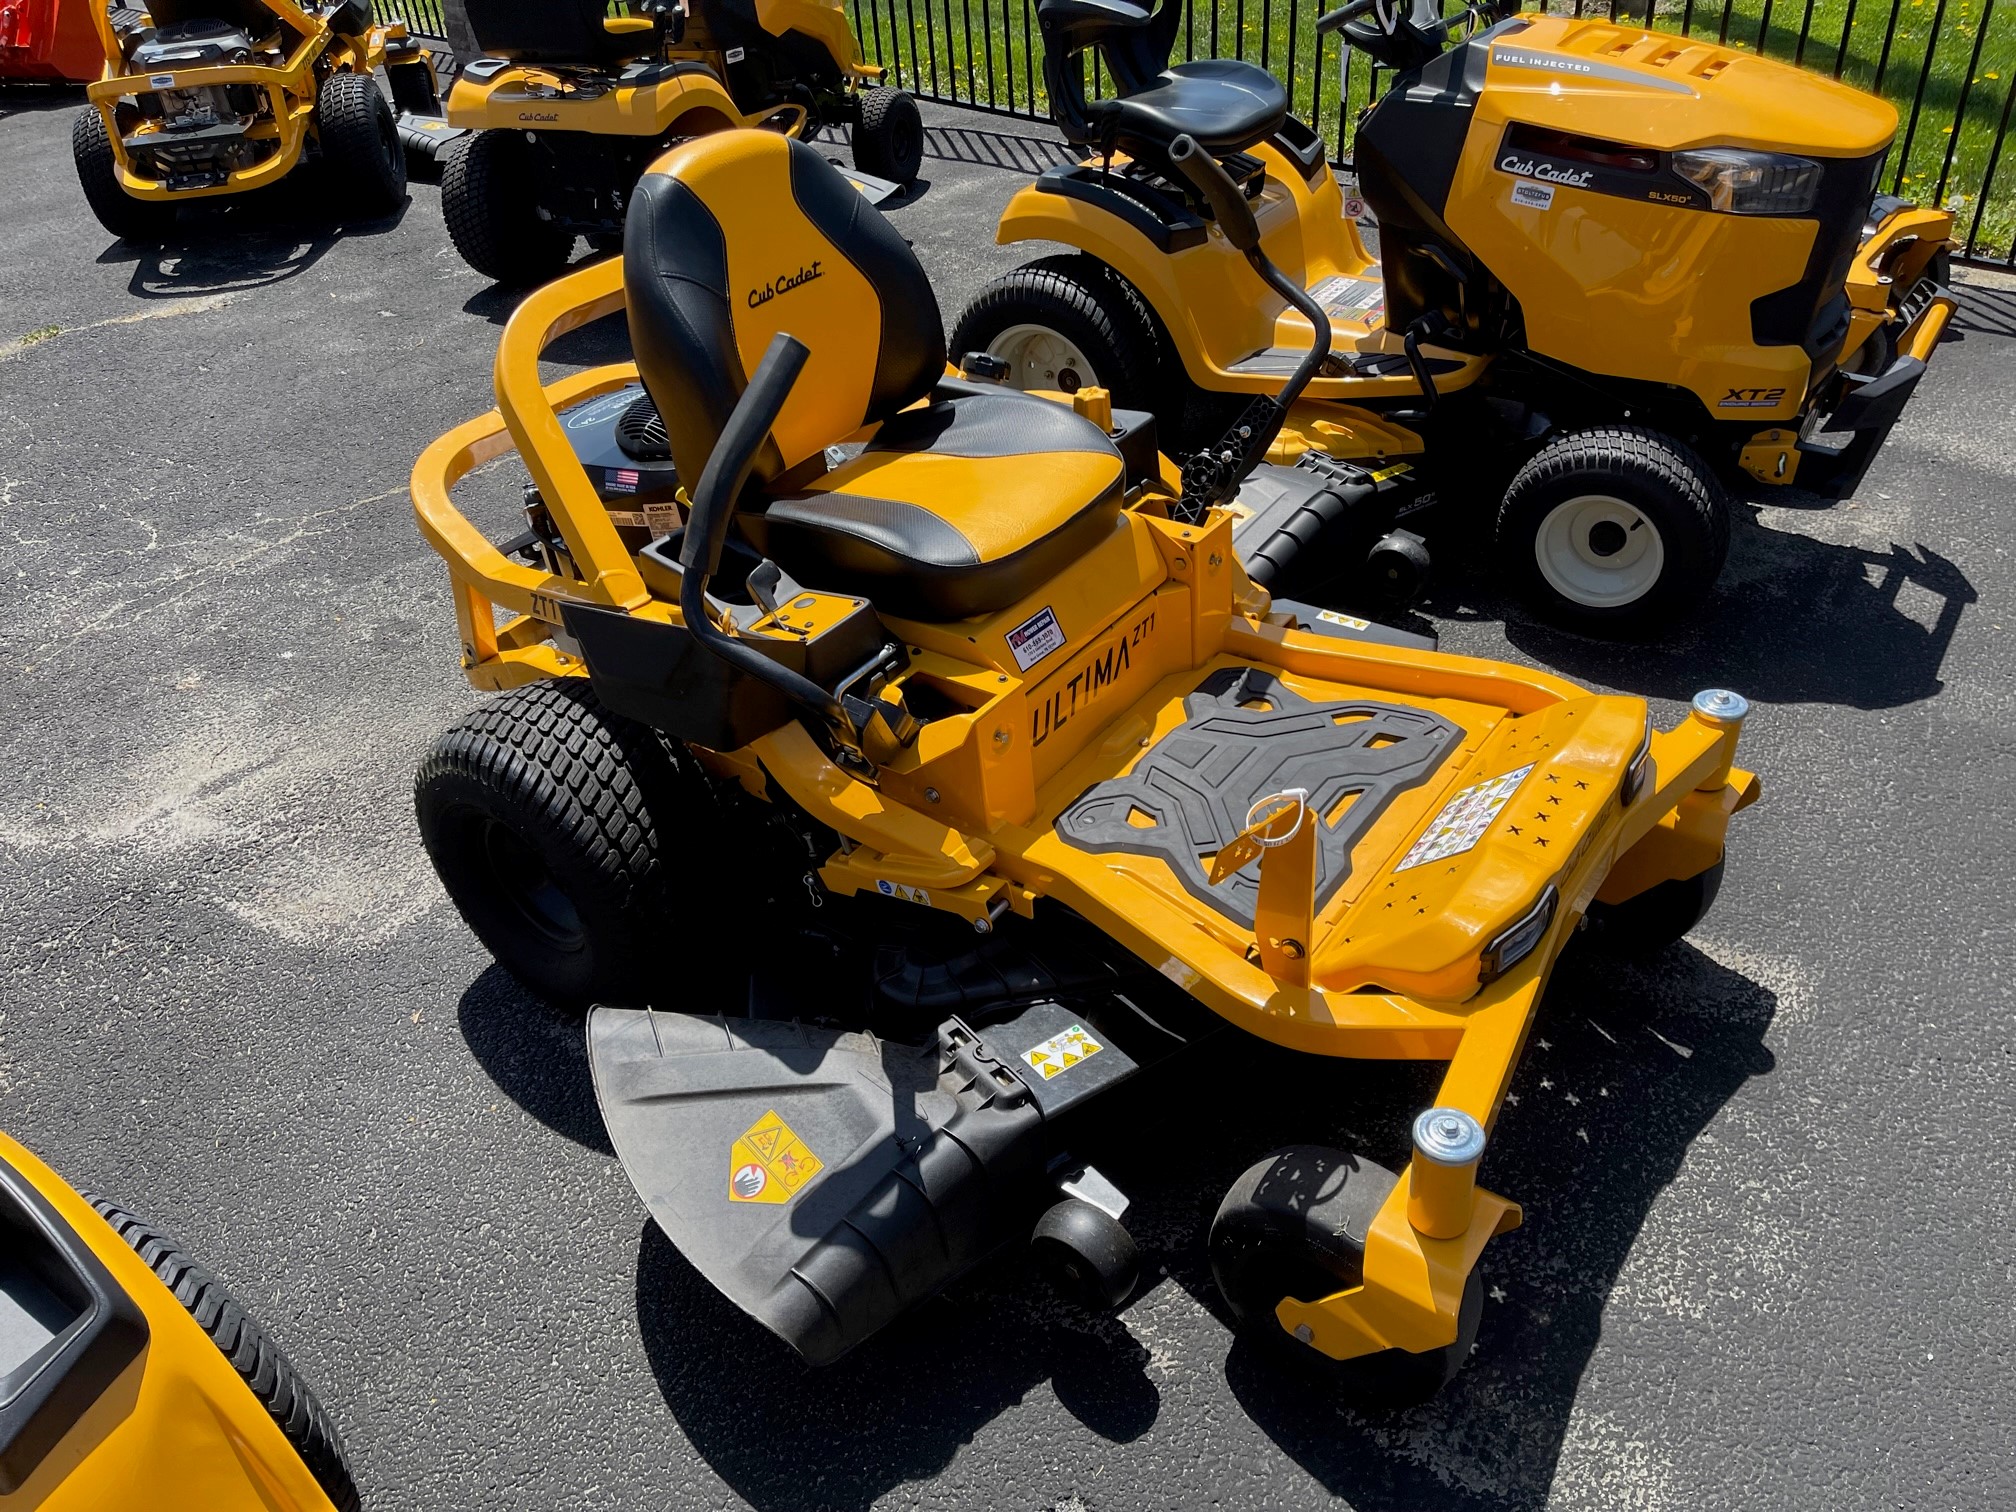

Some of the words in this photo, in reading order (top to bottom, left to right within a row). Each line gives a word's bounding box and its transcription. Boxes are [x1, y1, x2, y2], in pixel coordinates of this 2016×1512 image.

[1495, 54, 1525, 64] FUEL
[1529, 58, 1591, 72] INJECTED
[519, 112, 533, 121] Cub
[534, 113, 559, 122] Cadet
[1501, 156, 1534, 176] Cub
[1534, 163, 1594, 188] Cadet
[748, 283, 775, 309] Cub
[775, 261, 823, 295] Cadet
[1722, 388, 1786, 401] XT2
[648, 505, 673, 513] KOHLER
[530, 592, 557, 620] ZT1
[1032, 635, 1130, 748] ULTIMA
[1132, 612, 1155, 648] ZT1
